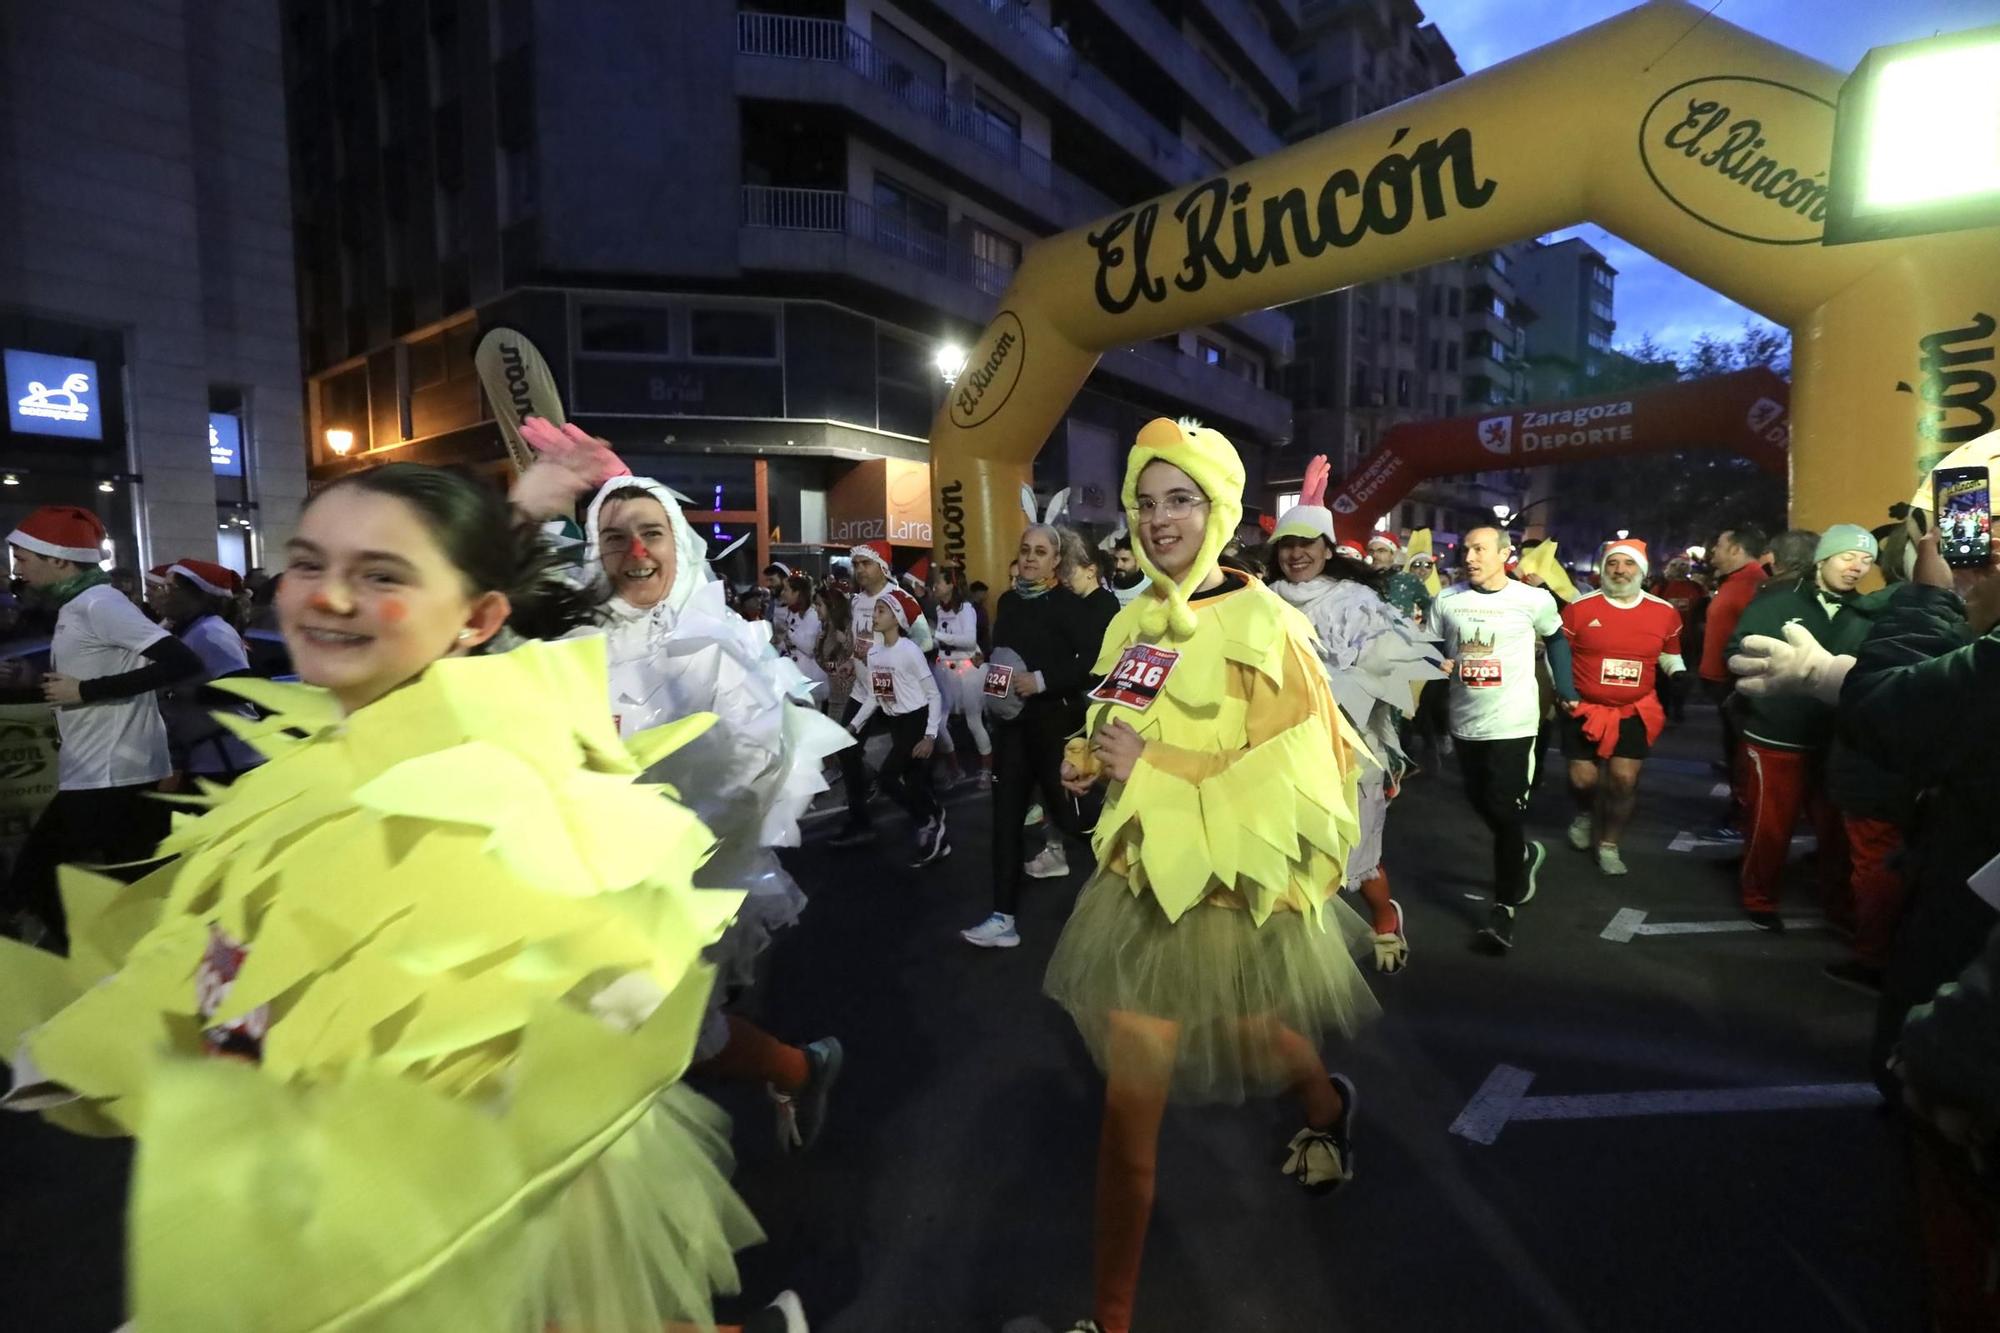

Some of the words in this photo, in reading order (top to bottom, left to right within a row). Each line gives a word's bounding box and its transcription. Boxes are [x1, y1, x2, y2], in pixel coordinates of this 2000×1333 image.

[1664, 98, 1730, 158] El
[1088, 202, 1167, 315] El
[1173, 127, 1498, 293] Rincón
[955, 387, 979, 416] El
[1521, 400, 1633, 429] Zaragoza
[1347, 448, 1393, 494] Zaragoza
[829, 517, 885, 540] Larraz
[888, 514, 932, 541] Larra
[1463, 666, 1499, 678] 3703
